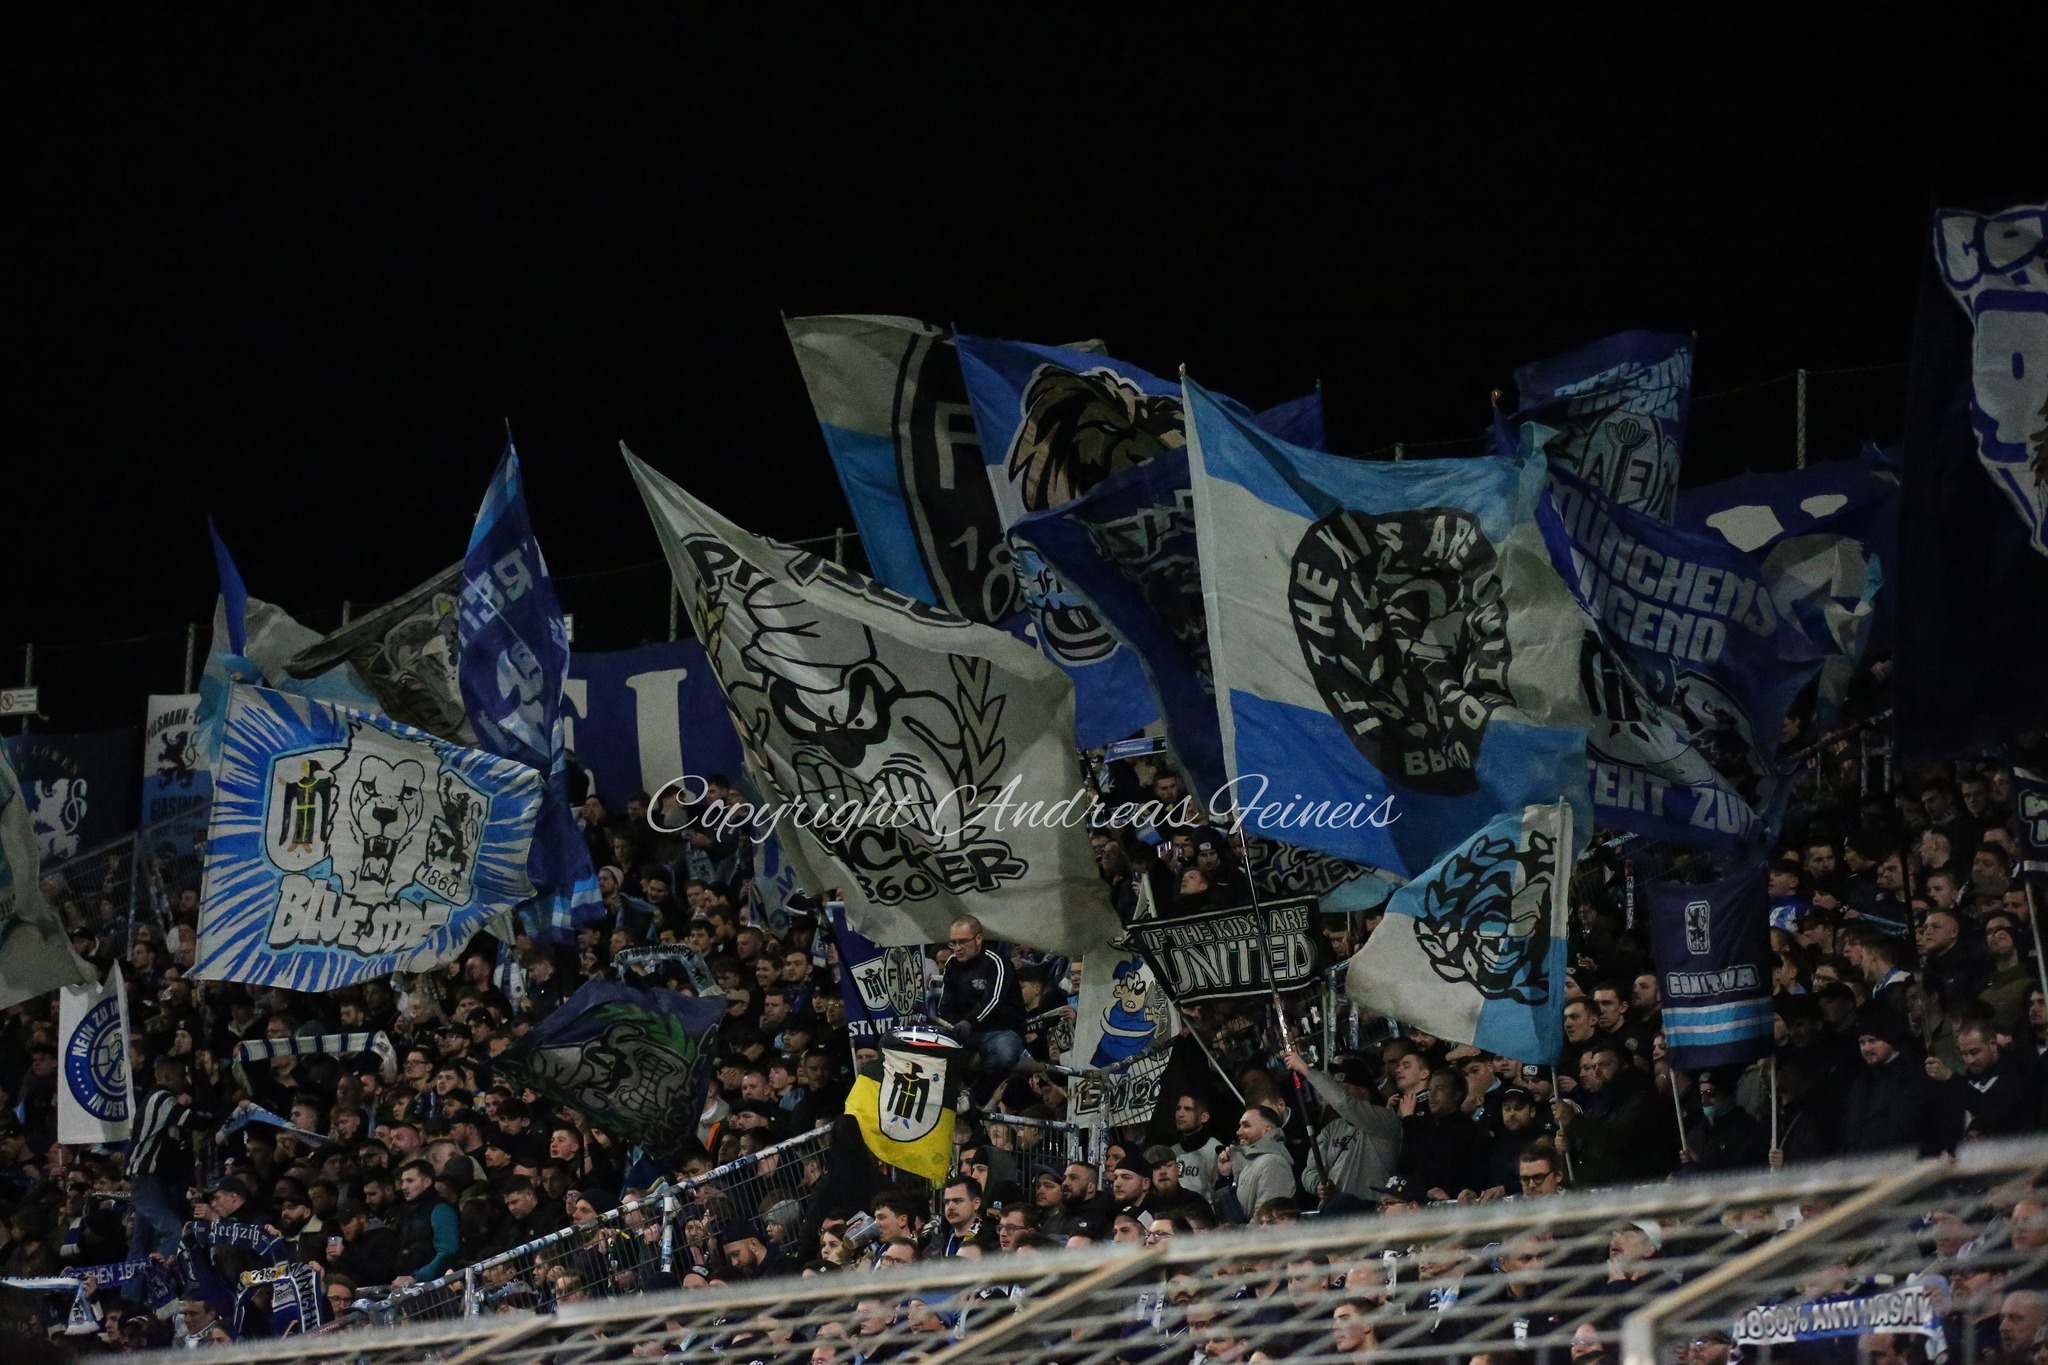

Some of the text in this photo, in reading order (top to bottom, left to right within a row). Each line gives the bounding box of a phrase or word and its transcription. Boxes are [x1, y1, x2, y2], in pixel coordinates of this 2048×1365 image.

[1316, 510, 1404, 571] KIS
[1294, 560, 1339, 667] THE
[1587, 759, 1671, 817] EHT
[422, 864, 460, 898] 1860
[1143, 906, 1309, 951] IF THE KIDS ARE
[1152, 932, 1318, 995] UNITED
[72, 1023, 96, 1058] NEIN
[91, 1006, 109, 1028] ZU
[87, 1092, 126, 1118] IN DER
[1811, 1300, 1860, 1332] ANTI
